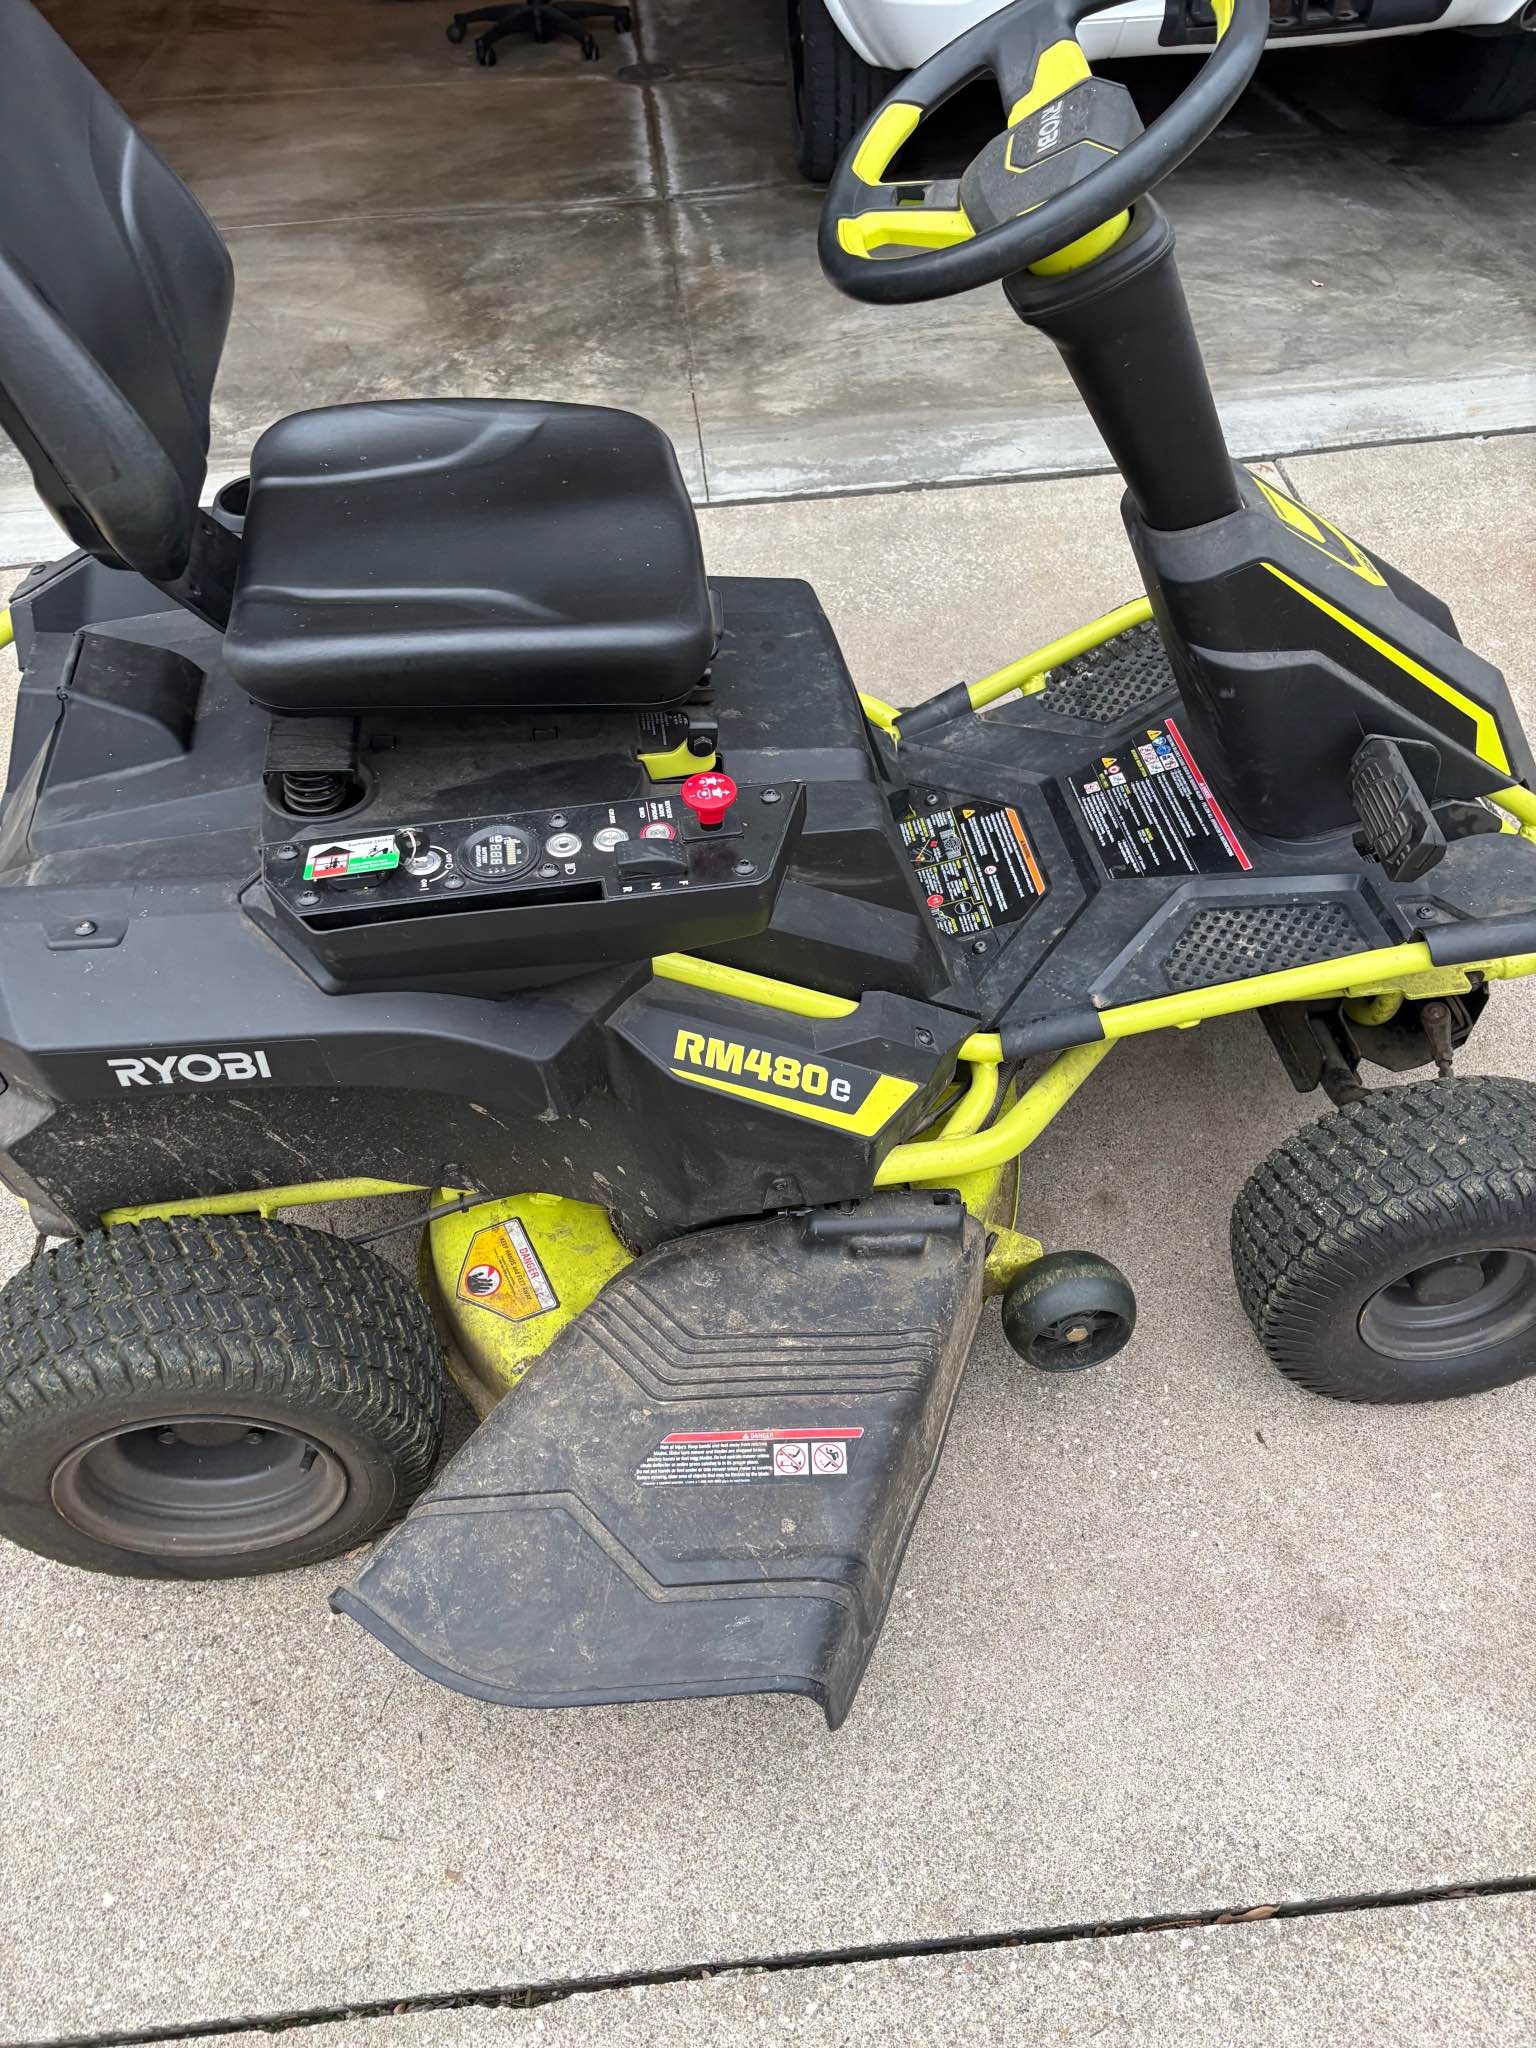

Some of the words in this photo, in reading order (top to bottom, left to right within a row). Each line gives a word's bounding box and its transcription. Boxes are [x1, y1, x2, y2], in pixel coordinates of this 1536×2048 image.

[1036, 100, 1062, 154] RYOBI
[651, 881, 662, 891] N
[106, 1050, 272, 1087] RYOBI
[673, 1029, 851, 1102] RM480e
[519, 1247, 540, 1279] DANGER
[750, 1431, 774, 1440] DANGER
